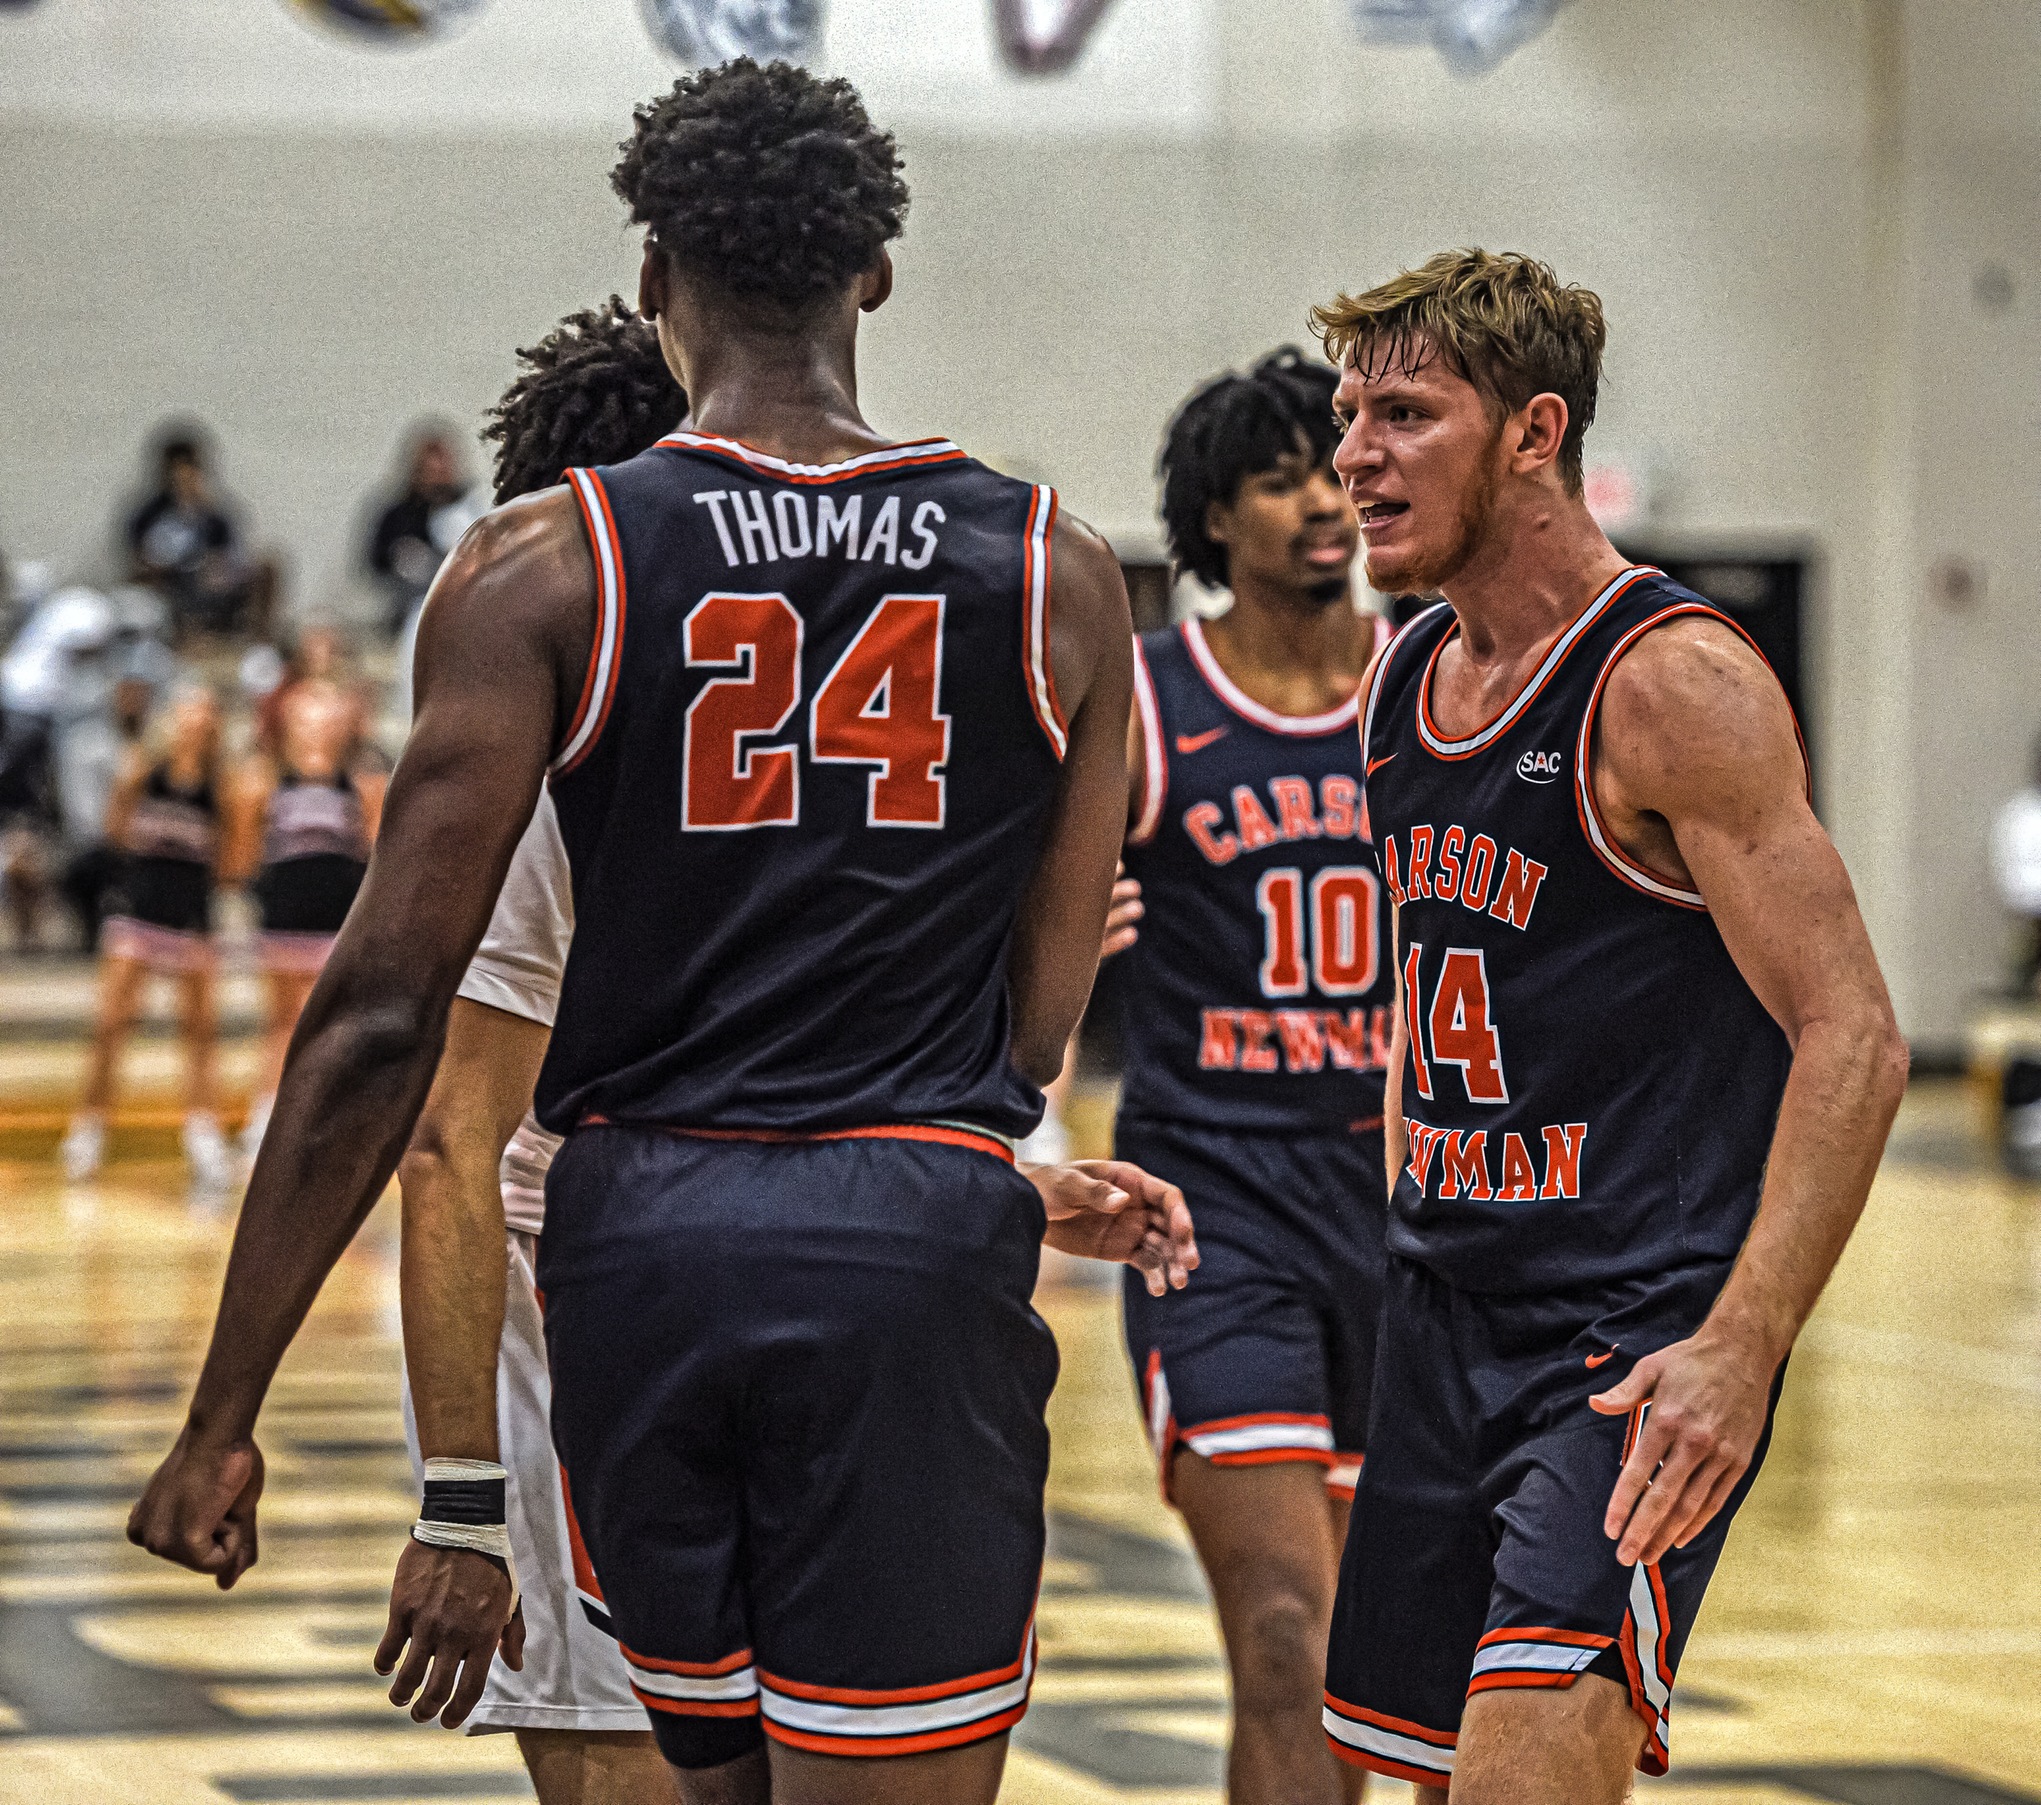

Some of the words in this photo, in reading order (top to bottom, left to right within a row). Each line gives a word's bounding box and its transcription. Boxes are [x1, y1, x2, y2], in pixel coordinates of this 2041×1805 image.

[693, 489, 946, 570] THOMAS
[681, 591, 951, 832] 24
[1520, 750, 1562, 774] SAC
[1182, 773, 1374, 866] CARS
[1376, 824, 1549, 932] ARSON
[1257, 866, 1380, 1000] 10
[1405, 942, 1510, 1105] 14
[1402, 1116, 1588, 1202] WMAN
